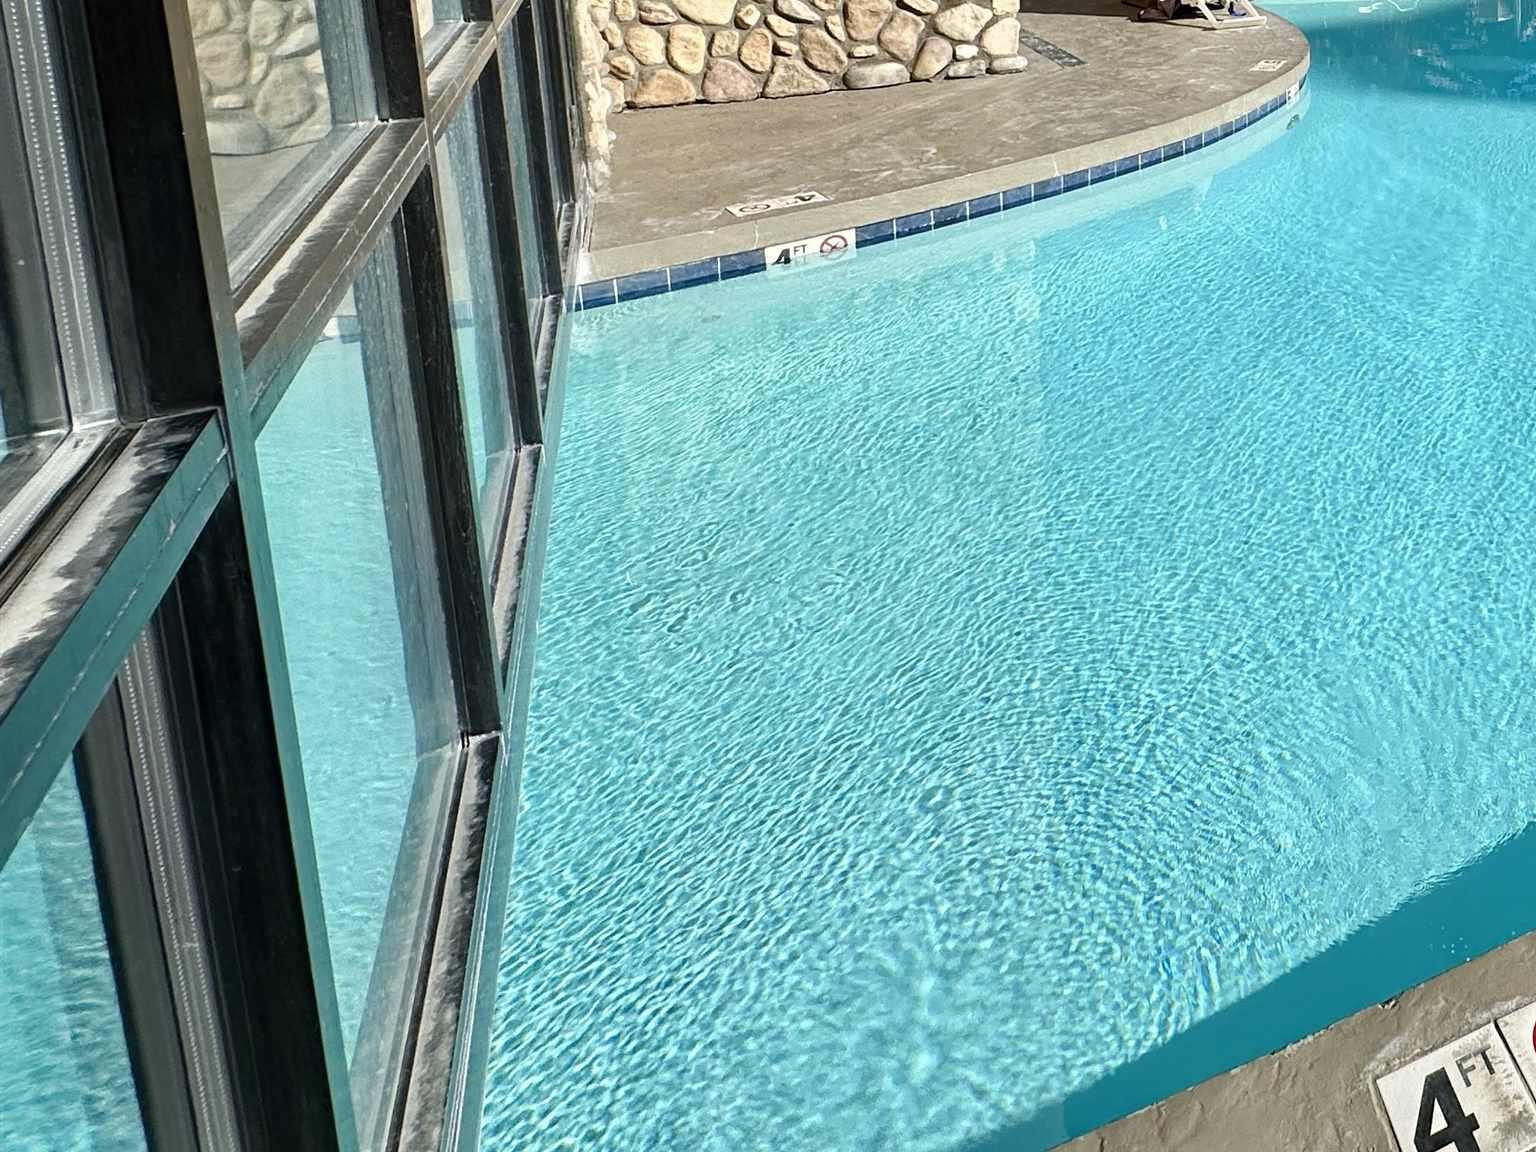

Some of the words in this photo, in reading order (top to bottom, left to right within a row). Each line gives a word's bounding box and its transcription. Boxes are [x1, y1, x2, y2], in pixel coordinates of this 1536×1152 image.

[773, 248, 791, 265] 4
[793, 244, 807, 256] FT
[1413, 1067, 1481, 1152] 4
[1456, 1047, 1496, 1087] FT
